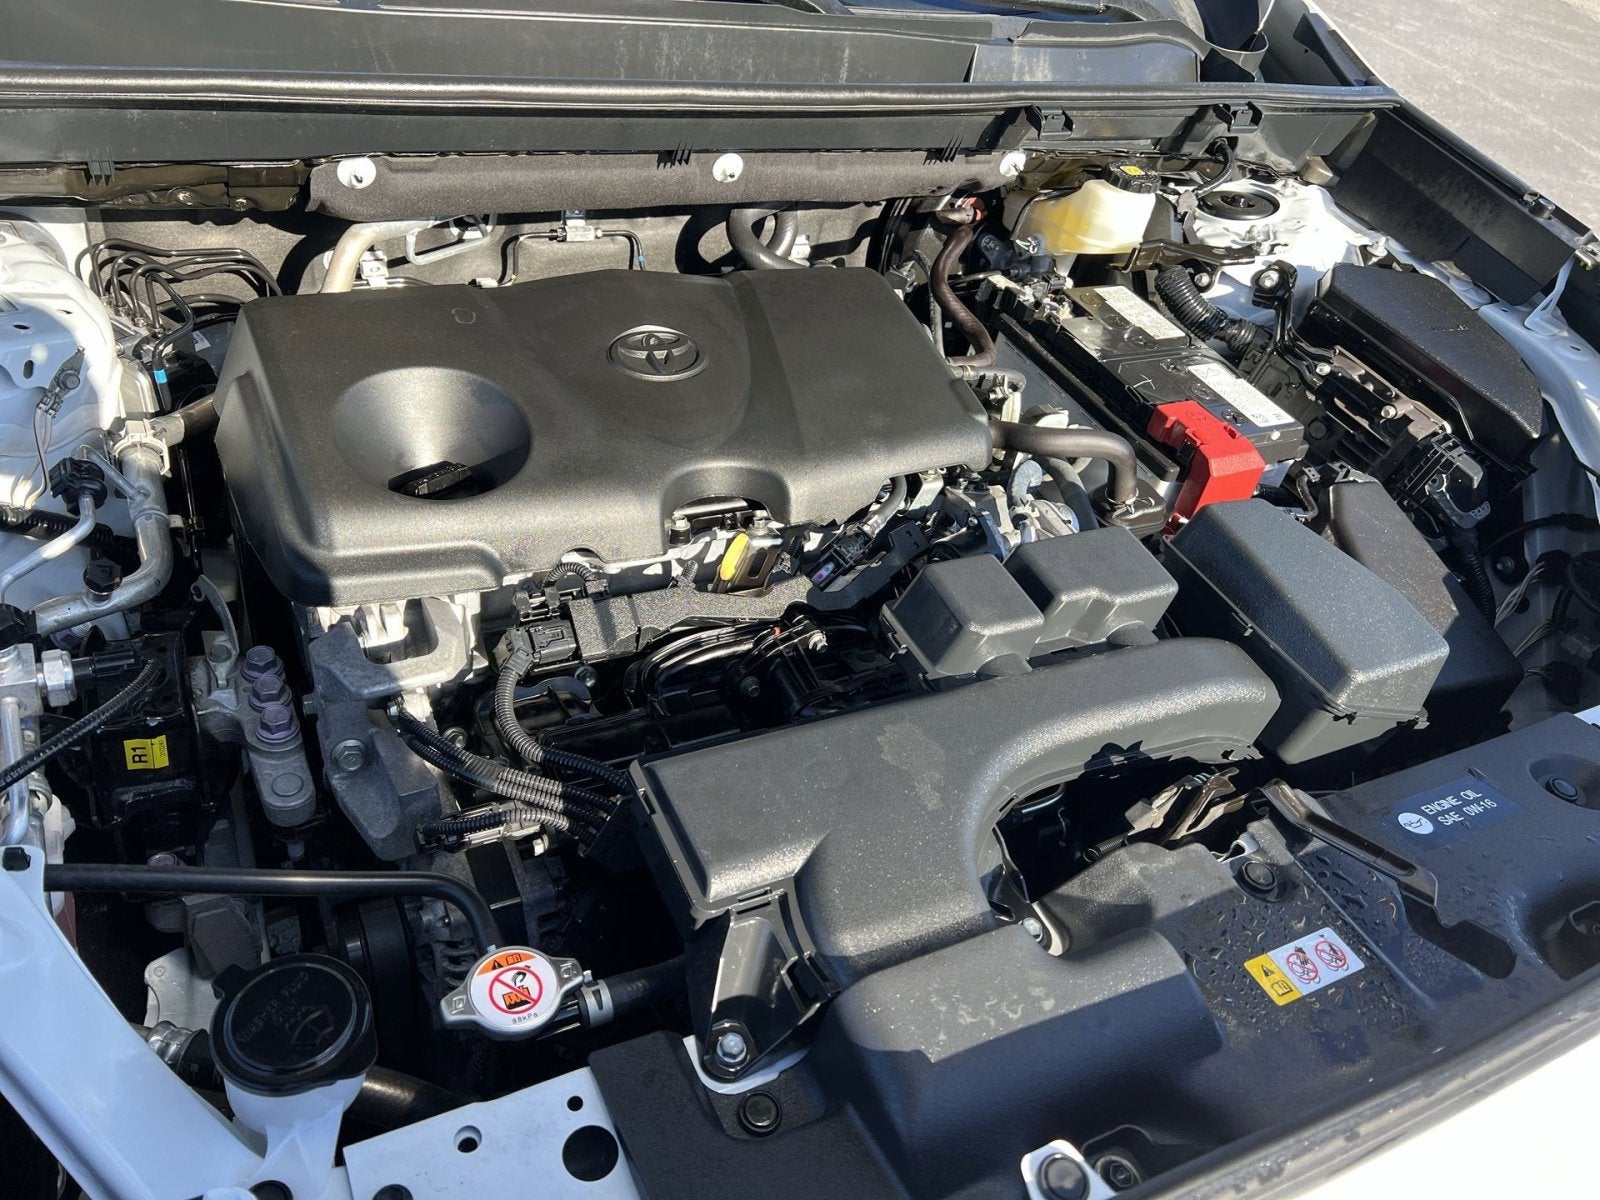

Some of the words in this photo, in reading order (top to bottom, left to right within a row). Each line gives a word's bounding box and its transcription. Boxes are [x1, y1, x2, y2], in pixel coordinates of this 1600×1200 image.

[131, 746, 148, 763] R1
[1421, 796, 1462, 815] ENGINE
[1460, 789, 1482, 800] OIL
[1437, 811, 1464, 826] SAE
[1463, 799, 1497, 816] 0W-16
